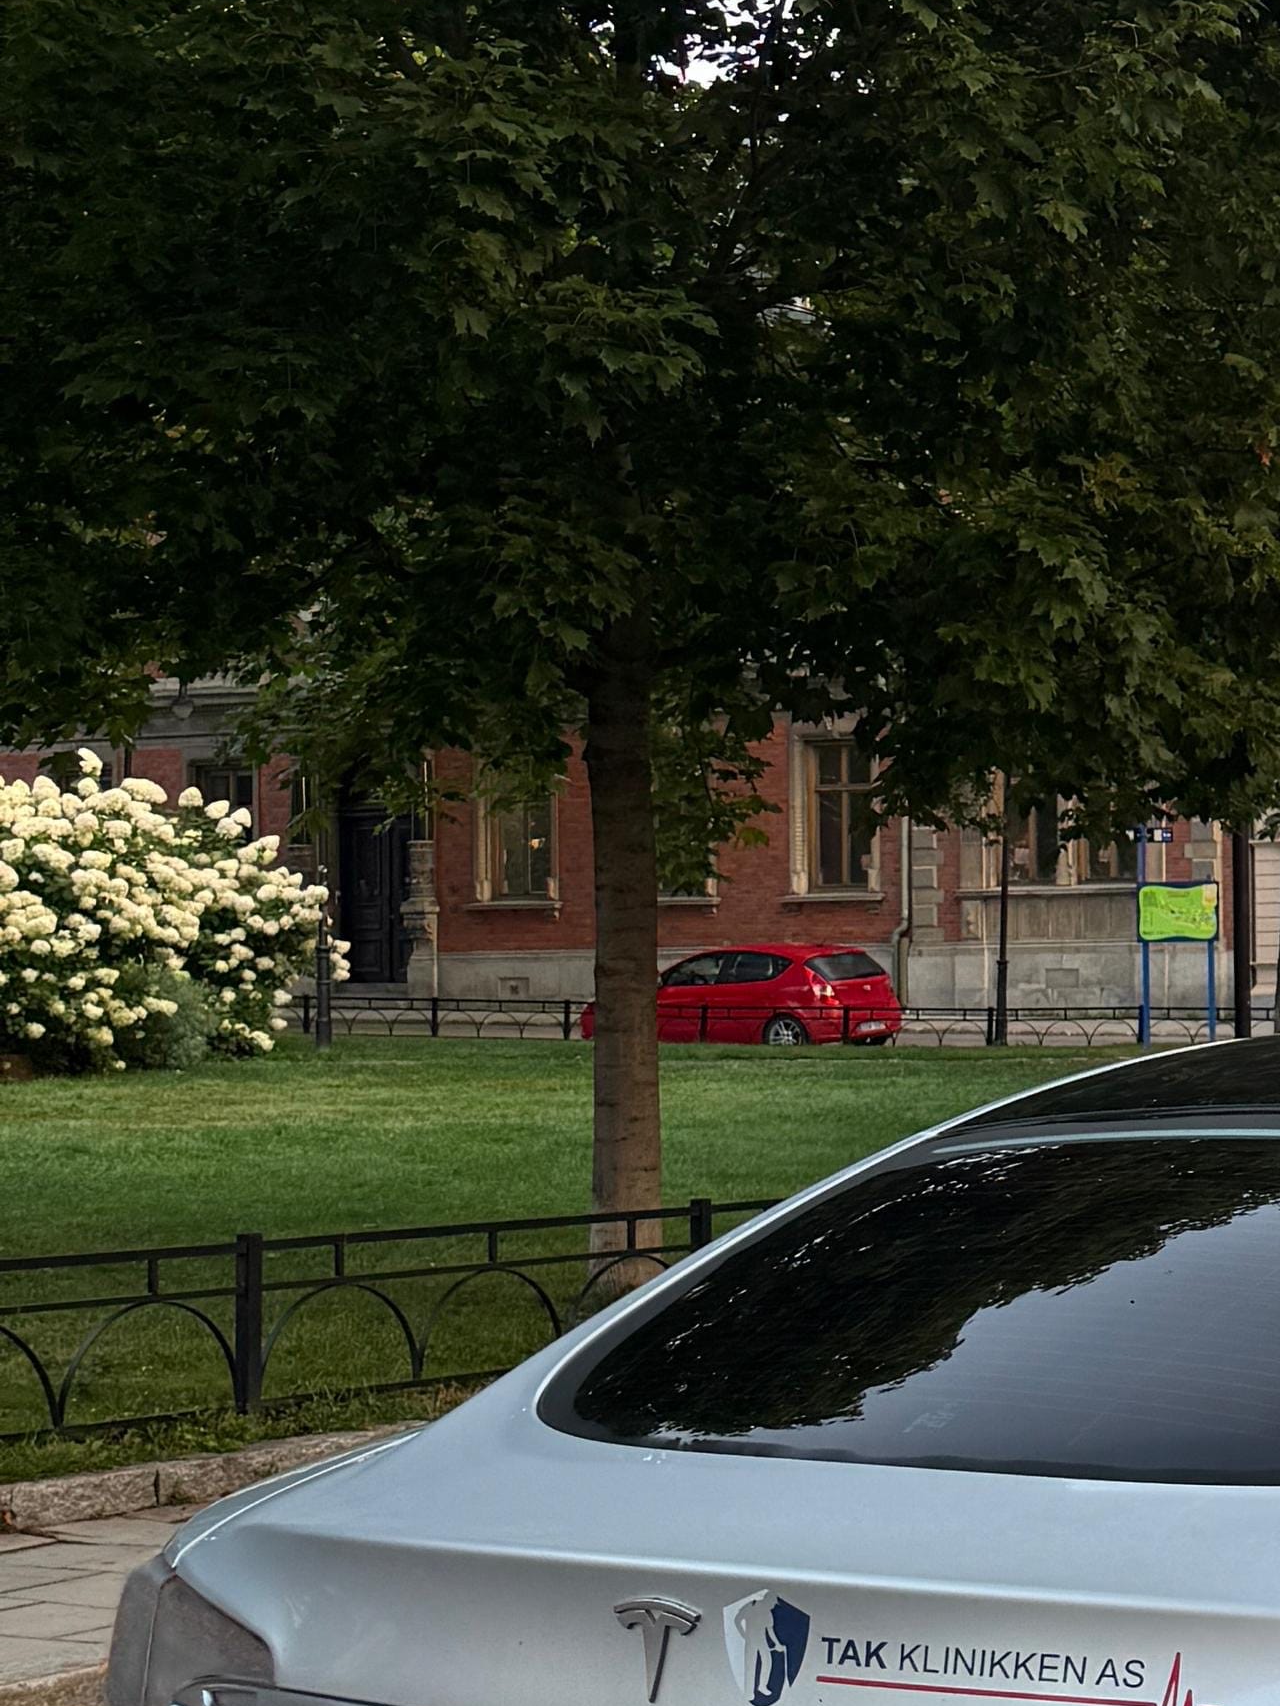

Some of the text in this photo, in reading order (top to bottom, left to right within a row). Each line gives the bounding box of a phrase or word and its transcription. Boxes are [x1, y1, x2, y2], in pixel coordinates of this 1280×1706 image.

[821, 1636, 1146, 1689] TAK KLINIKKEN AS
